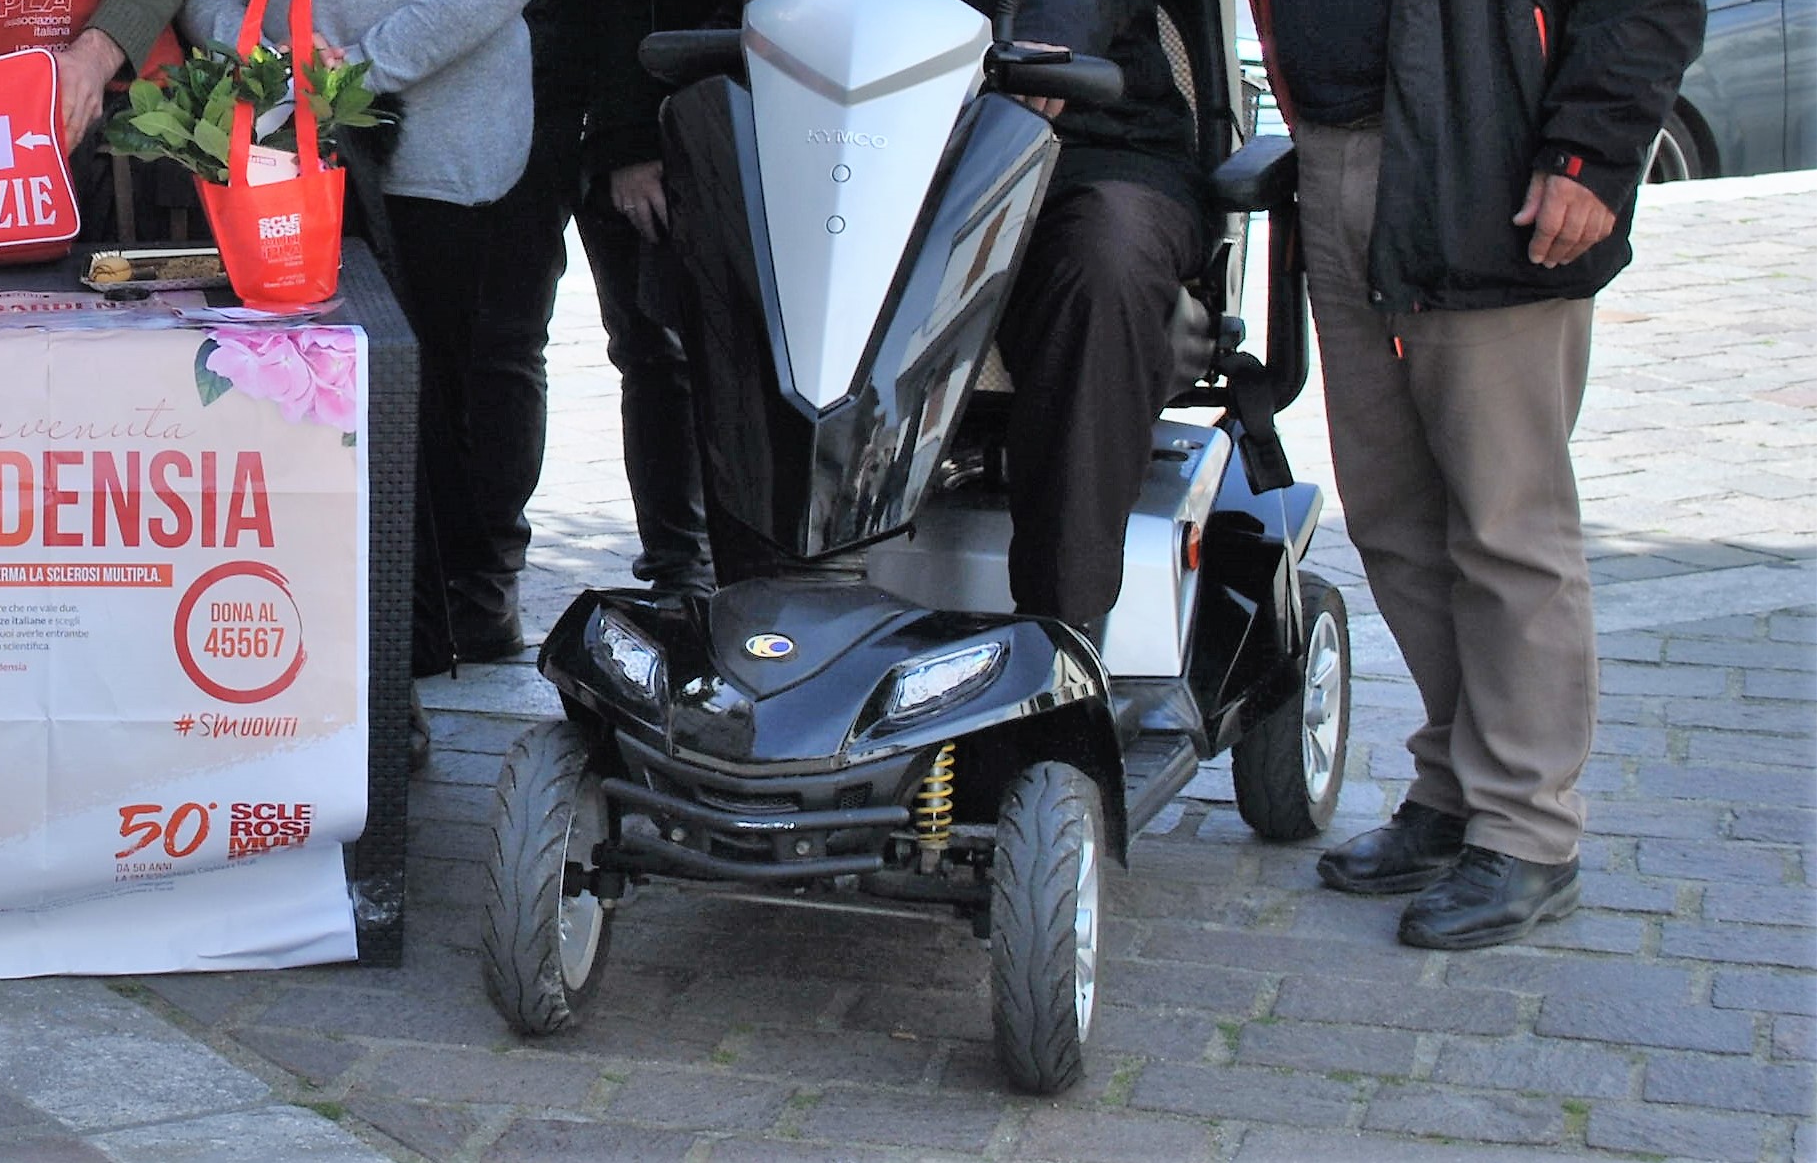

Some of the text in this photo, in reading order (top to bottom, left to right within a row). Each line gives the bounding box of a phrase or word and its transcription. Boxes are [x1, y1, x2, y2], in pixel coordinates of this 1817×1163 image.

[33, 26, 70, 37] italiana
[807, 128, 888, 150] KYMCO
[29, 567, 44, 582] LA
[47, 567, 100, 582] SCLEROSI
[103, 567, 161, 582] MULTIPLA.
[9, 604, 25, 613] che
[26, 604, 38, 613] ne
[39, 604, 57, 613] vale
[59, 604, 79, 613] due.
[211, 603, 278, 622] DONA AL
[12, 616, 46, 627] italiane
[55, 616, 80, 627] scegli
[16, 630, 43, 639] averle
[45, 630, 89, 639] entrambe
[3, 643, 49, 652] scientifica.
[204, 627, 285, 658] 45567
[231, 804, 311, 819] SCLE
[116, 863, 130, 873] DA
[134, 863, 146, 872] 50
[149, 861, 173, 871] ANNI
